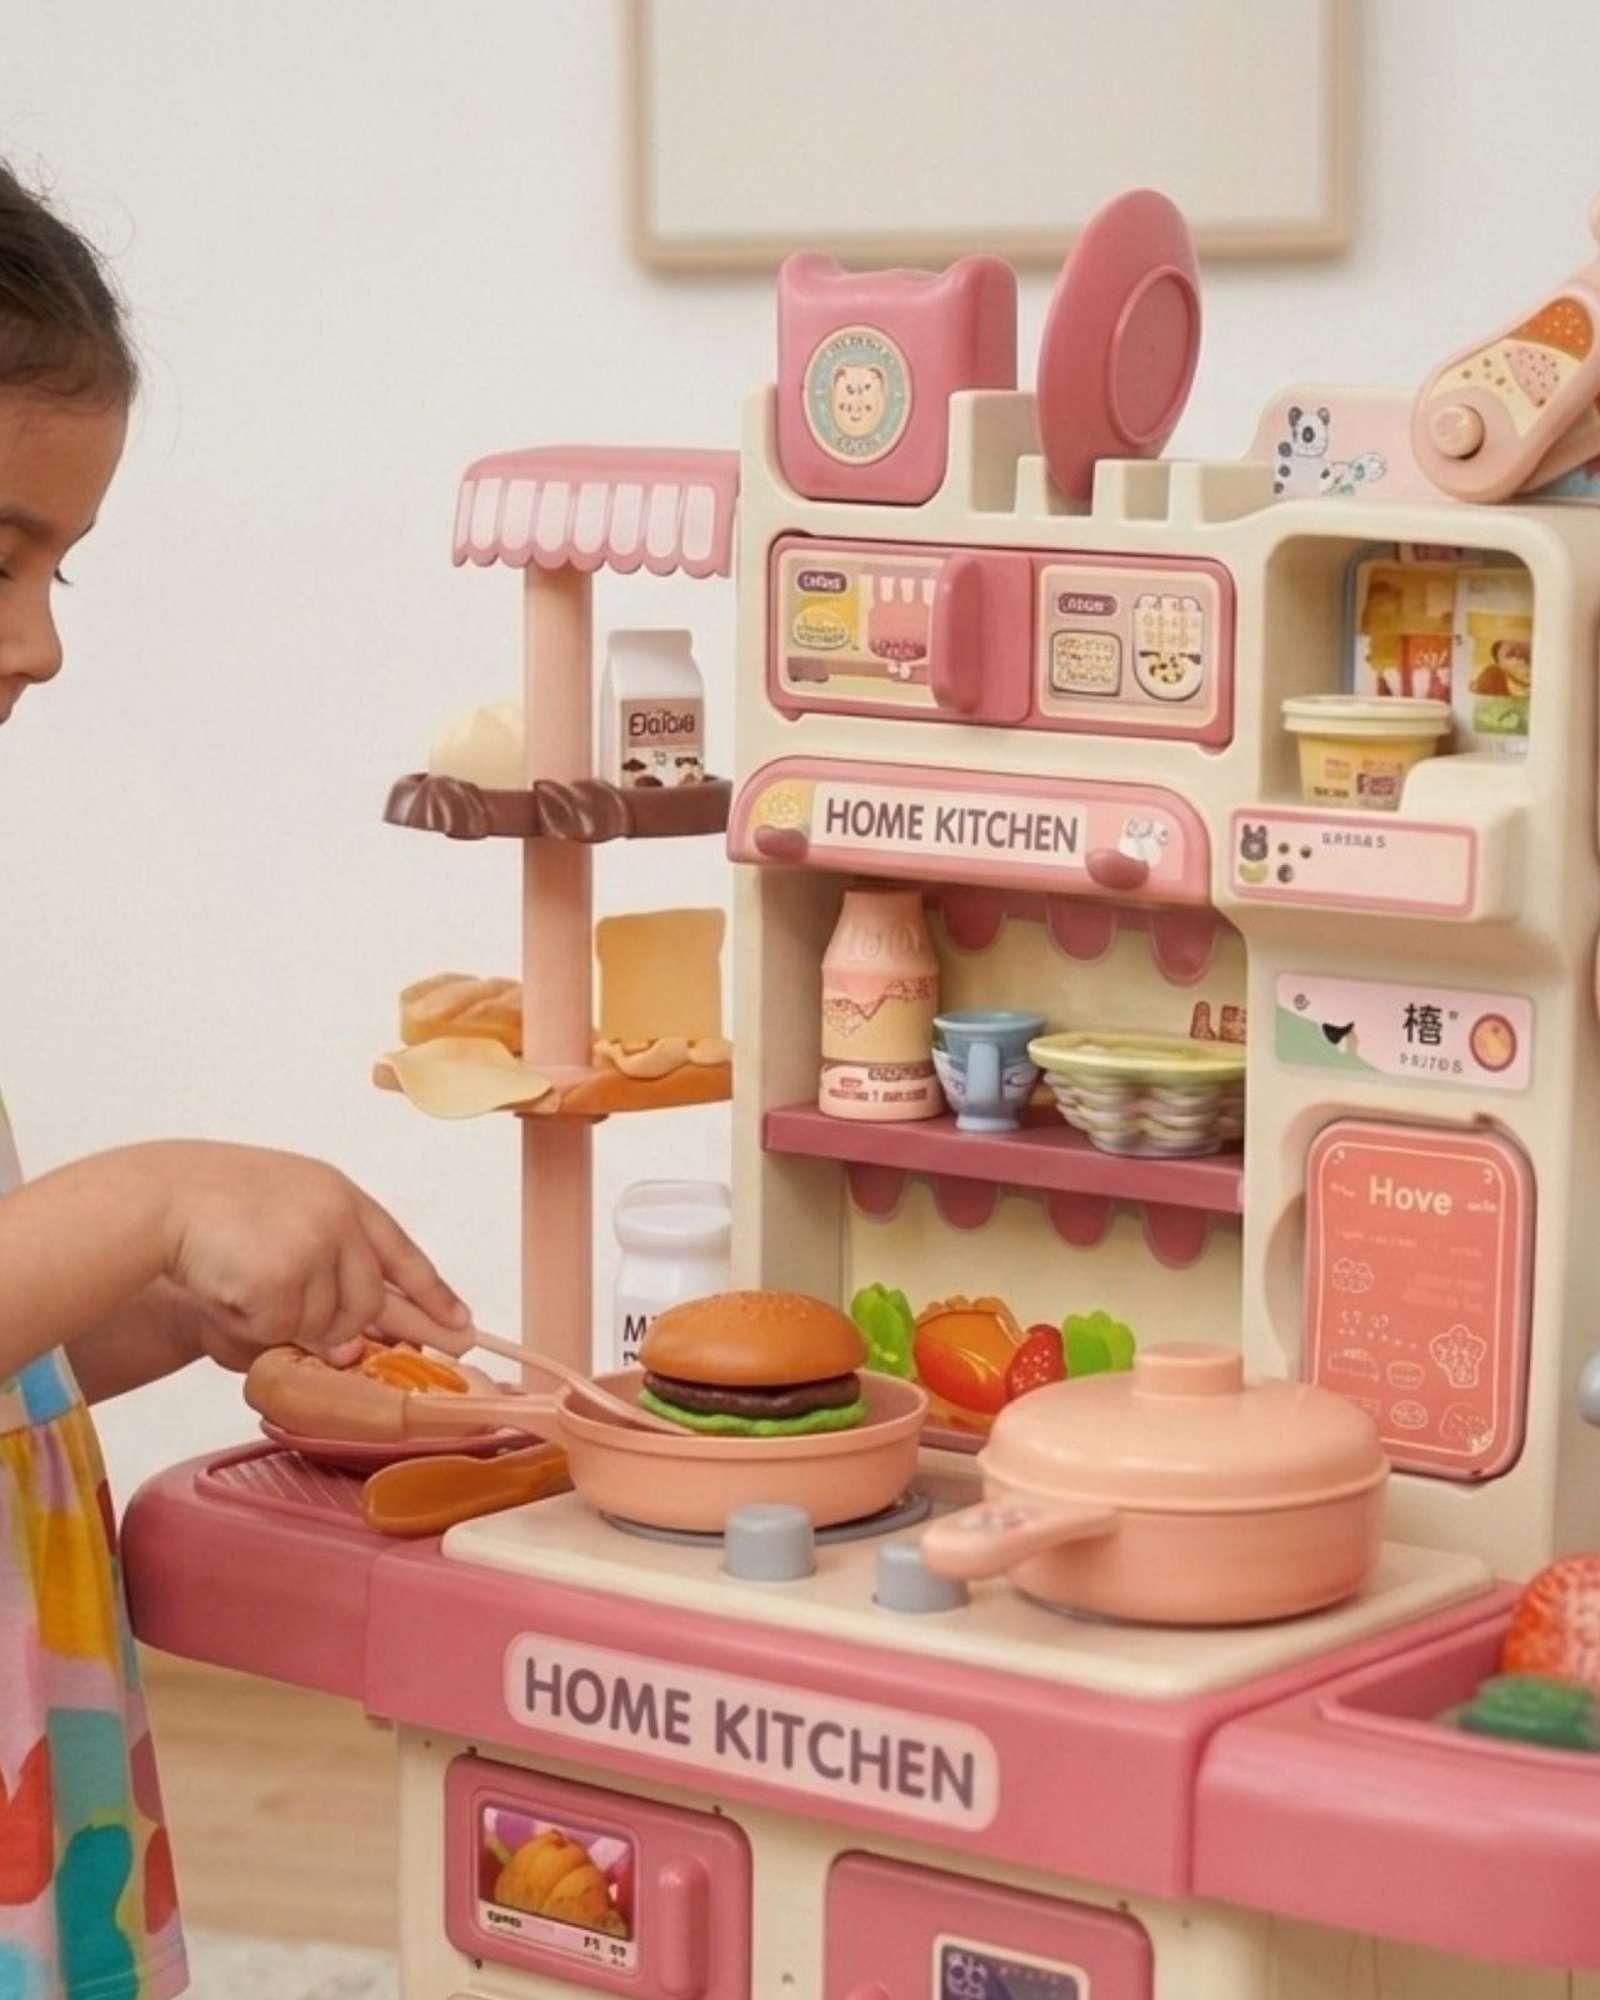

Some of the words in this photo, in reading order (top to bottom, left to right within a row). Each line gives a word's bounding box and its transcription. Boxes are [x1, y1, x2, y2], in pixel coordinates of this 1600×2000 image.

[826, 797, 924, 841] HOME
[934, 805, 1079, 853] KITCHEN
[1368, 1175, 1453, 1216] Hove
[623, 1314, 658, 1342] M
[524, 1656, 691, 1747] HOME
[713, 1698, 975, 1811] KITCHEN
